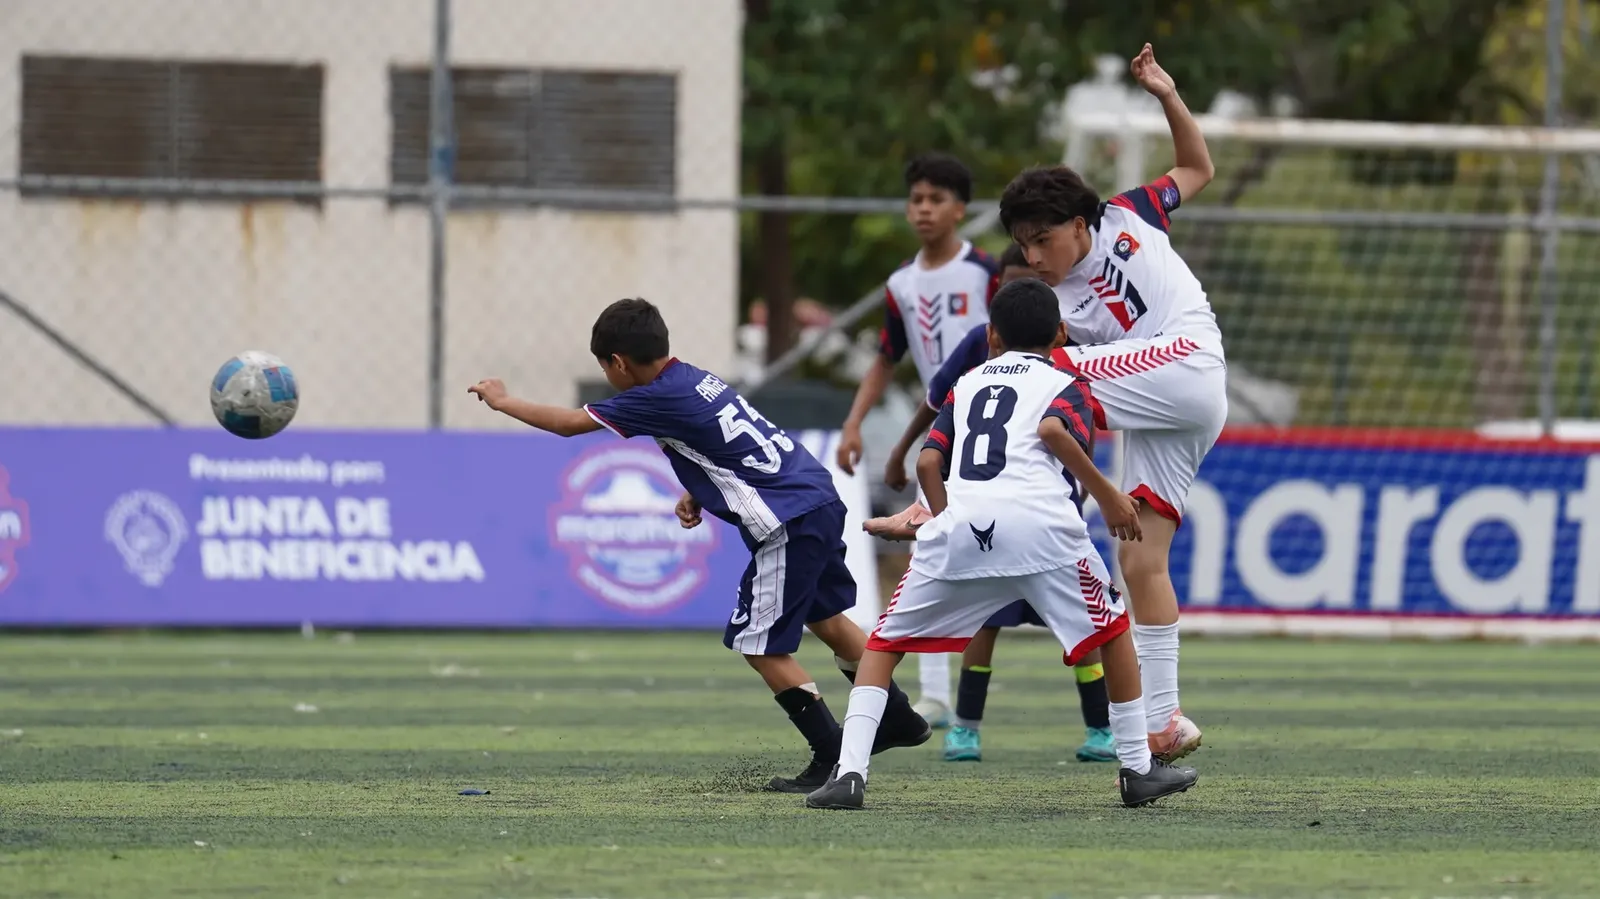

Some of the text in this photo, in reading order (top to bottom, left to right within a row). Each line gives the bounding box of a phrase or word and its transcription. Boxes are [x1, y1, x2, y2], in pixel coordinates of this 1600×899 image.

[959, 384, 1018, 481] 8
[198, 496, 391, 539] JUNTA DE
[201, 540, 485, 582] BENEFICENCIA
